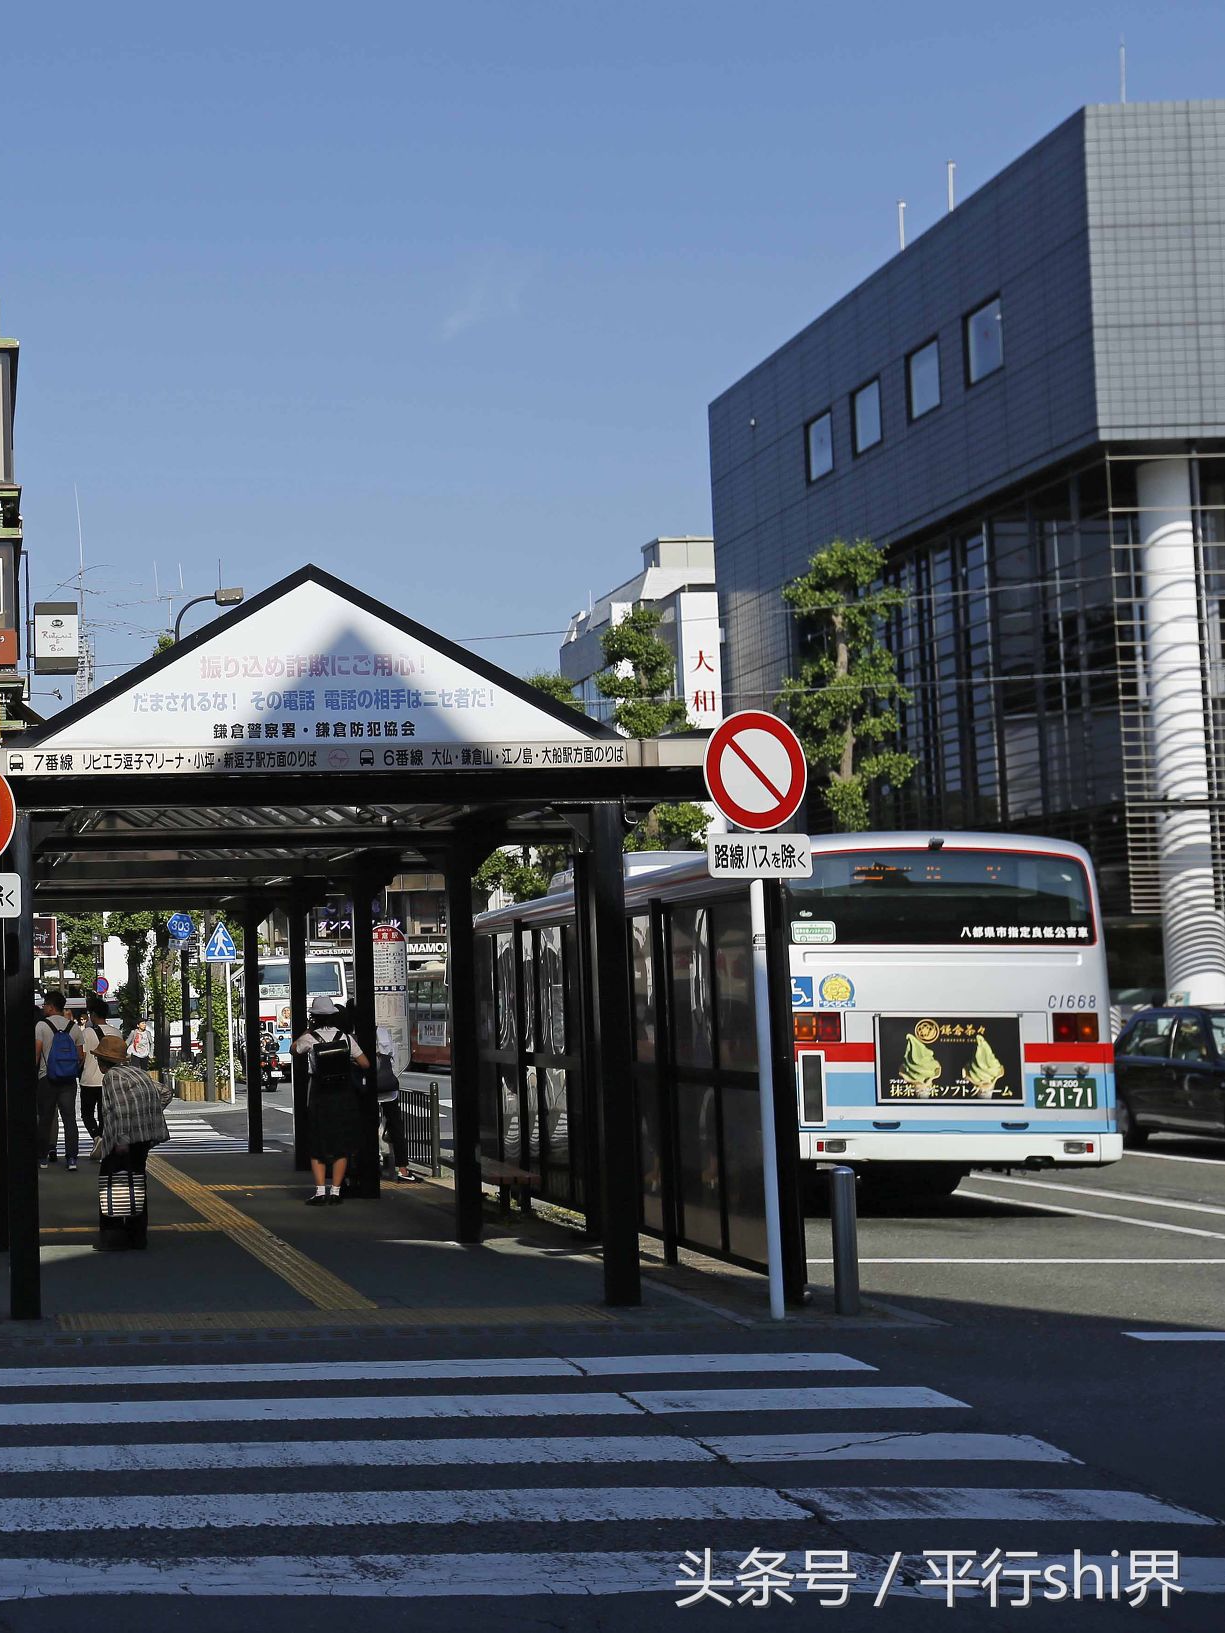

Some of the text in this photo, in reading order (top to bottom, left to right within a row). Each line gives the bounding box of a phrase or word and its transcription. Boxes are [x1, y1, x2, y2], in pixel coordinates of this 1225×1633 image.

[690, 649, 716, 713] 大和
[132, 691, 239, 713] だまされるな！
[251, 689, 316, 711] その電話
[213, 720, 416, 740] 鎌倉警察署・鎌倉防犯協会
[33, 753, 74, 771] 7番線
[383, 745, 625, 767] 6番線 大仏・鎌倉山・江ノ島・大船駅方面のりば
[714, 843, 807, 870] 路線バスを除く
[171, 920, 190, 932] 303
[1047, 994, 1097, 1009] C1668
[1045, 1087, 1093, 1108] 21-71
